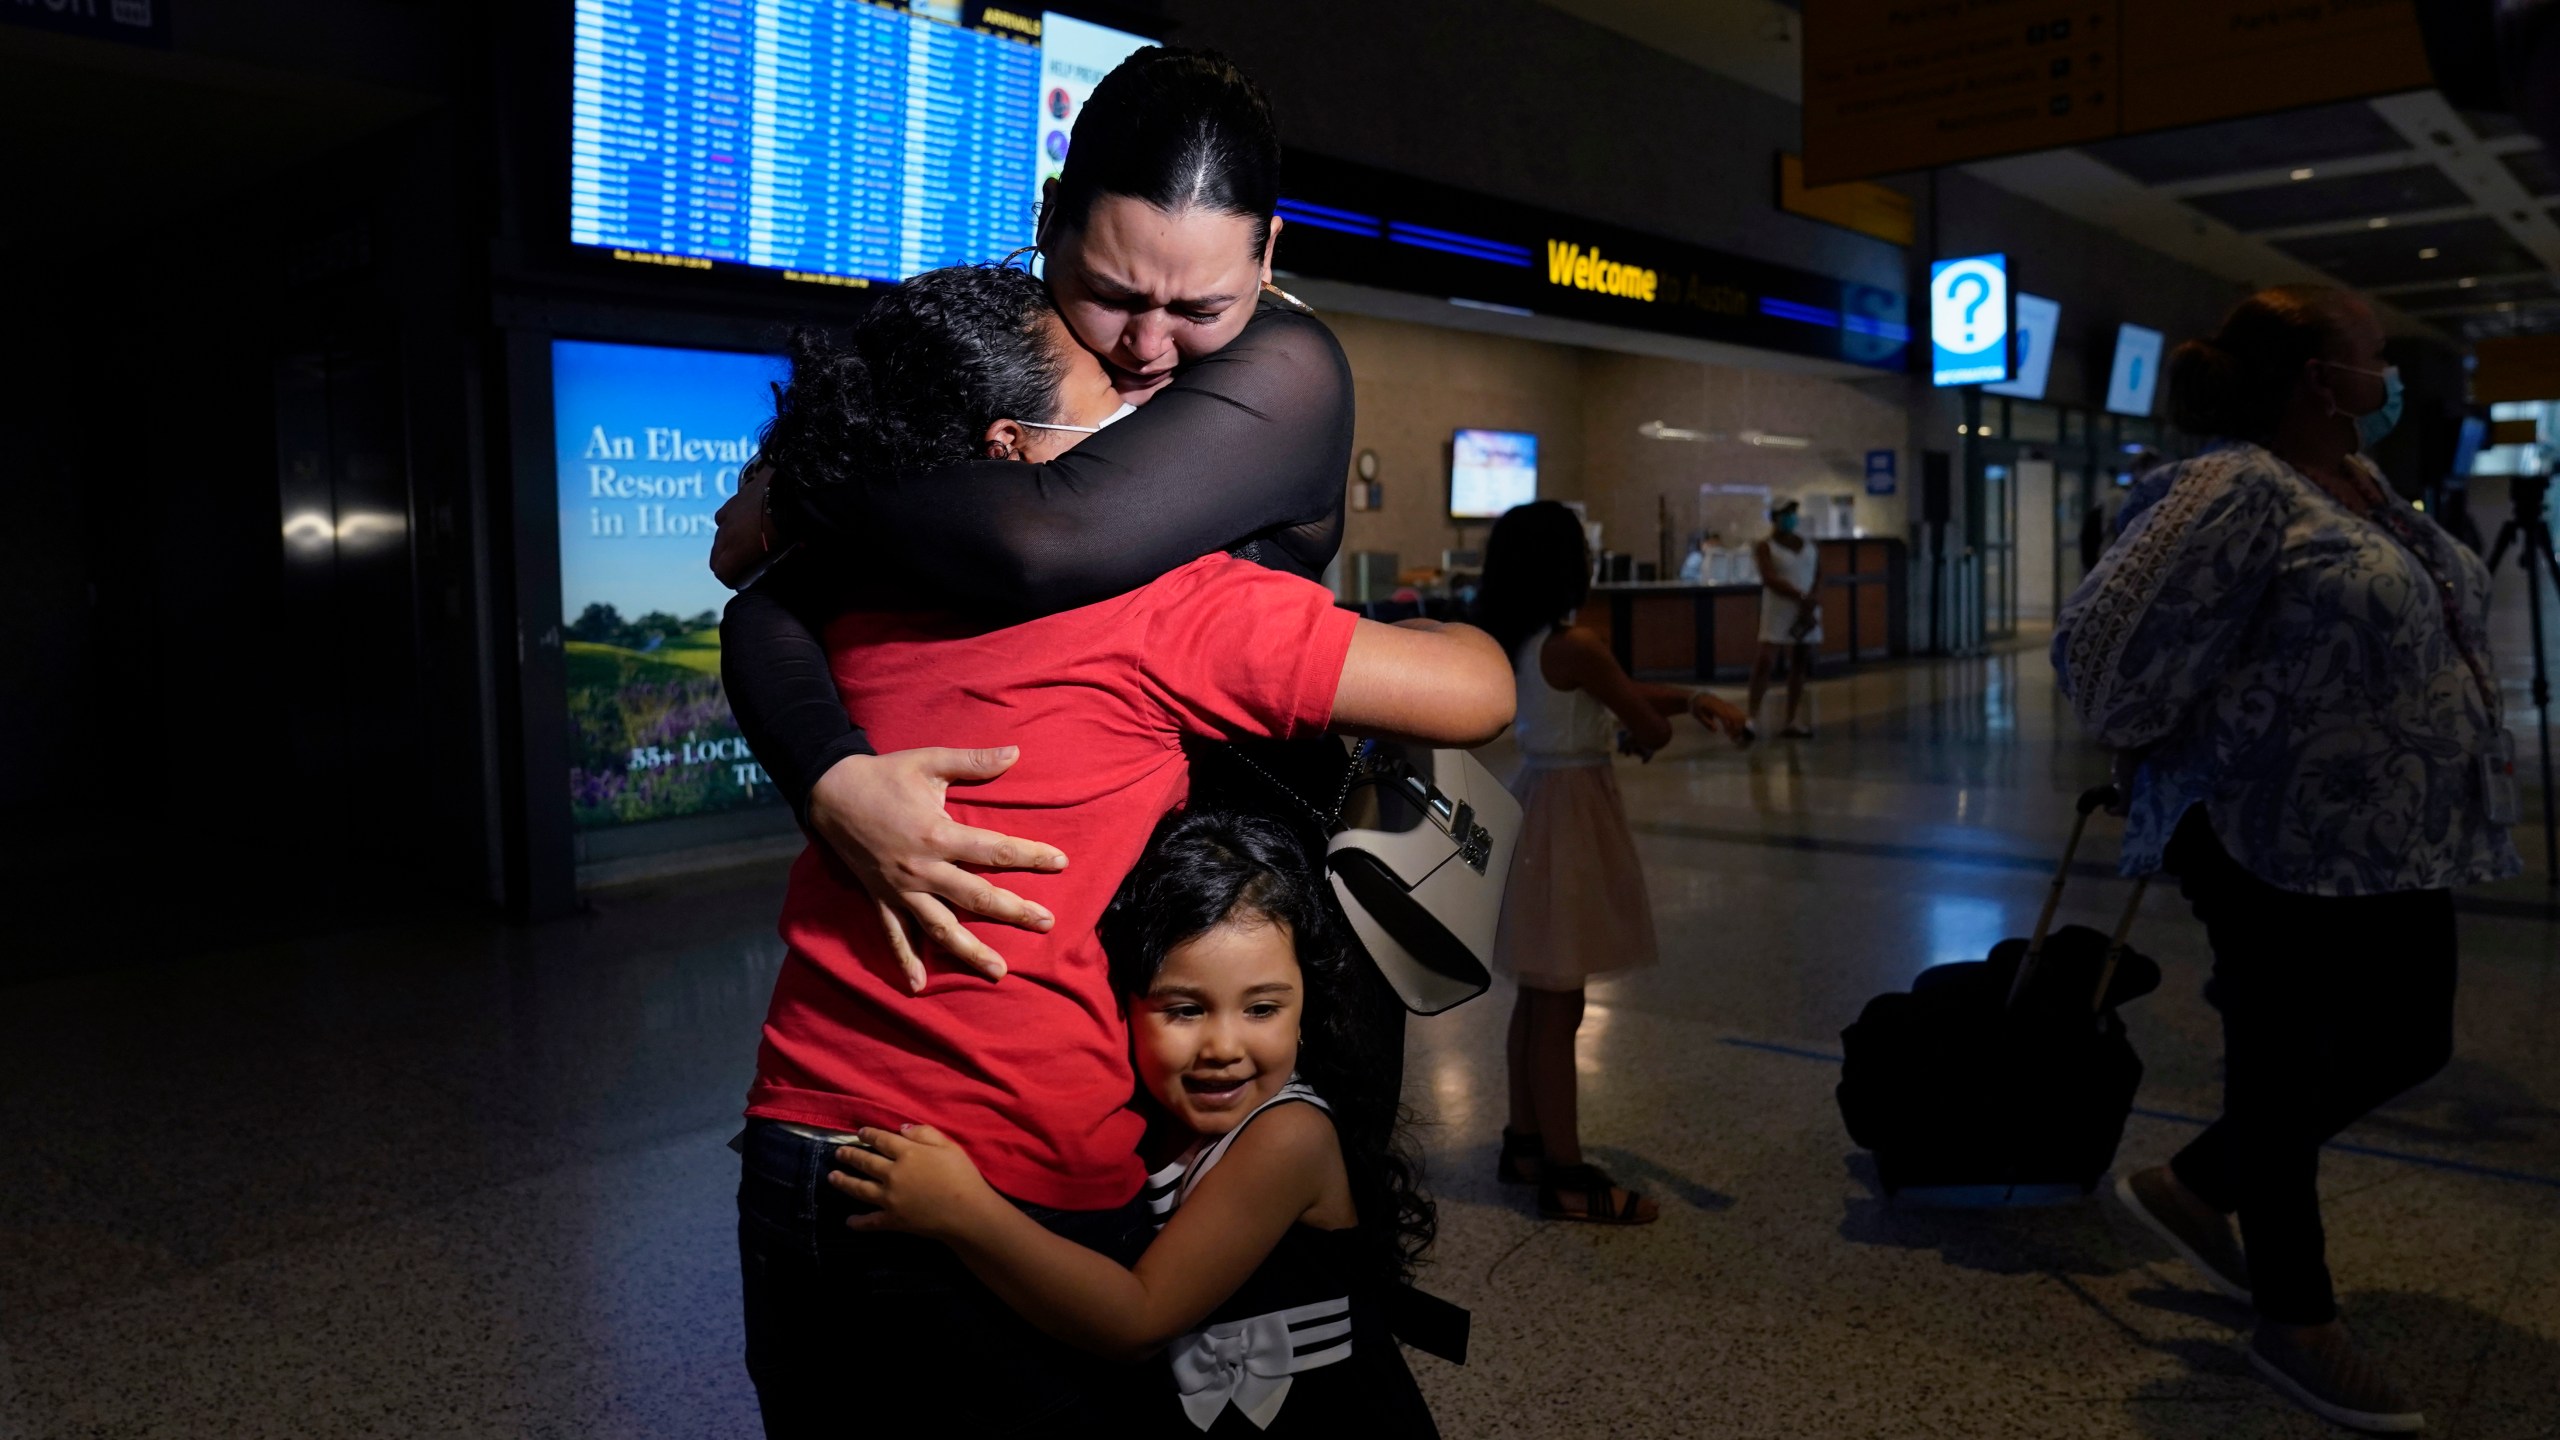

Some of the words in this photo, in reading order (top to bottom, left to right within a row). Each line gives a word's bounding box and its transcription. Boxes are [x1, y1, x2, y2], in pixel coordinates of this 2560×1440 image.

[983, 6, 1042, 36] ARRIVALS
[1546, 237, 1659, 303] Welcome
[1660, 271, 1681, 304] to
[585, 425, 635, 459] An
[588, 464, 704, 499] Resort
[591, 505, 624, 537] in
[628, 745, 674, 771] 55+
[683, 737, 752, 766] LOCK
